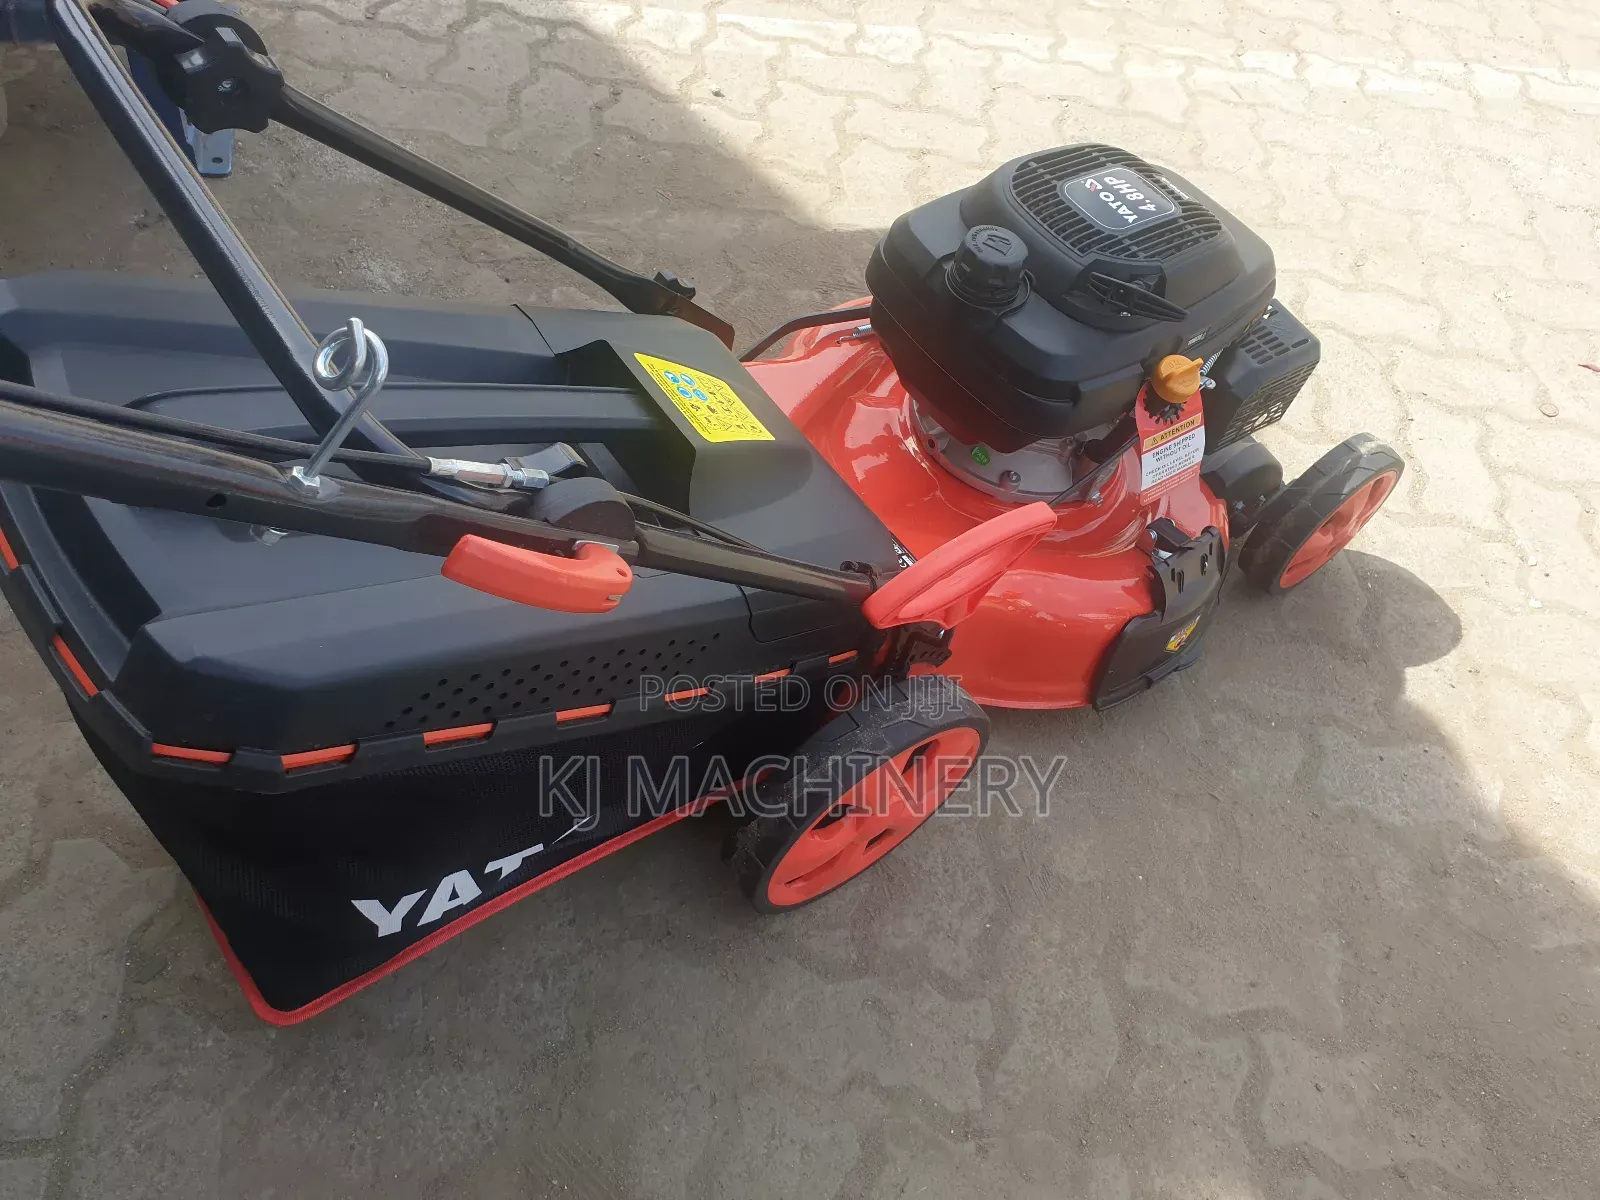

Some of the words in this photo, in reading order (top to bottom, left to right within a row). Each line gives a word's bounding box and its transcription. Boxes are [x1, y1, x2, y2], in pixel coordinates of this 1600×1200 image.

[1103, 176, 1157, 212] 4.8HP
[1099, 191, 1139, 224] YATO
[1160, 419, 1195, 441] ATTENTION
[1152, 444, 1173, 459] ENGINE
[1173, 433, 1196, 448] SHIPPED
[1155, 446, 1182, 463] WITHOUT
